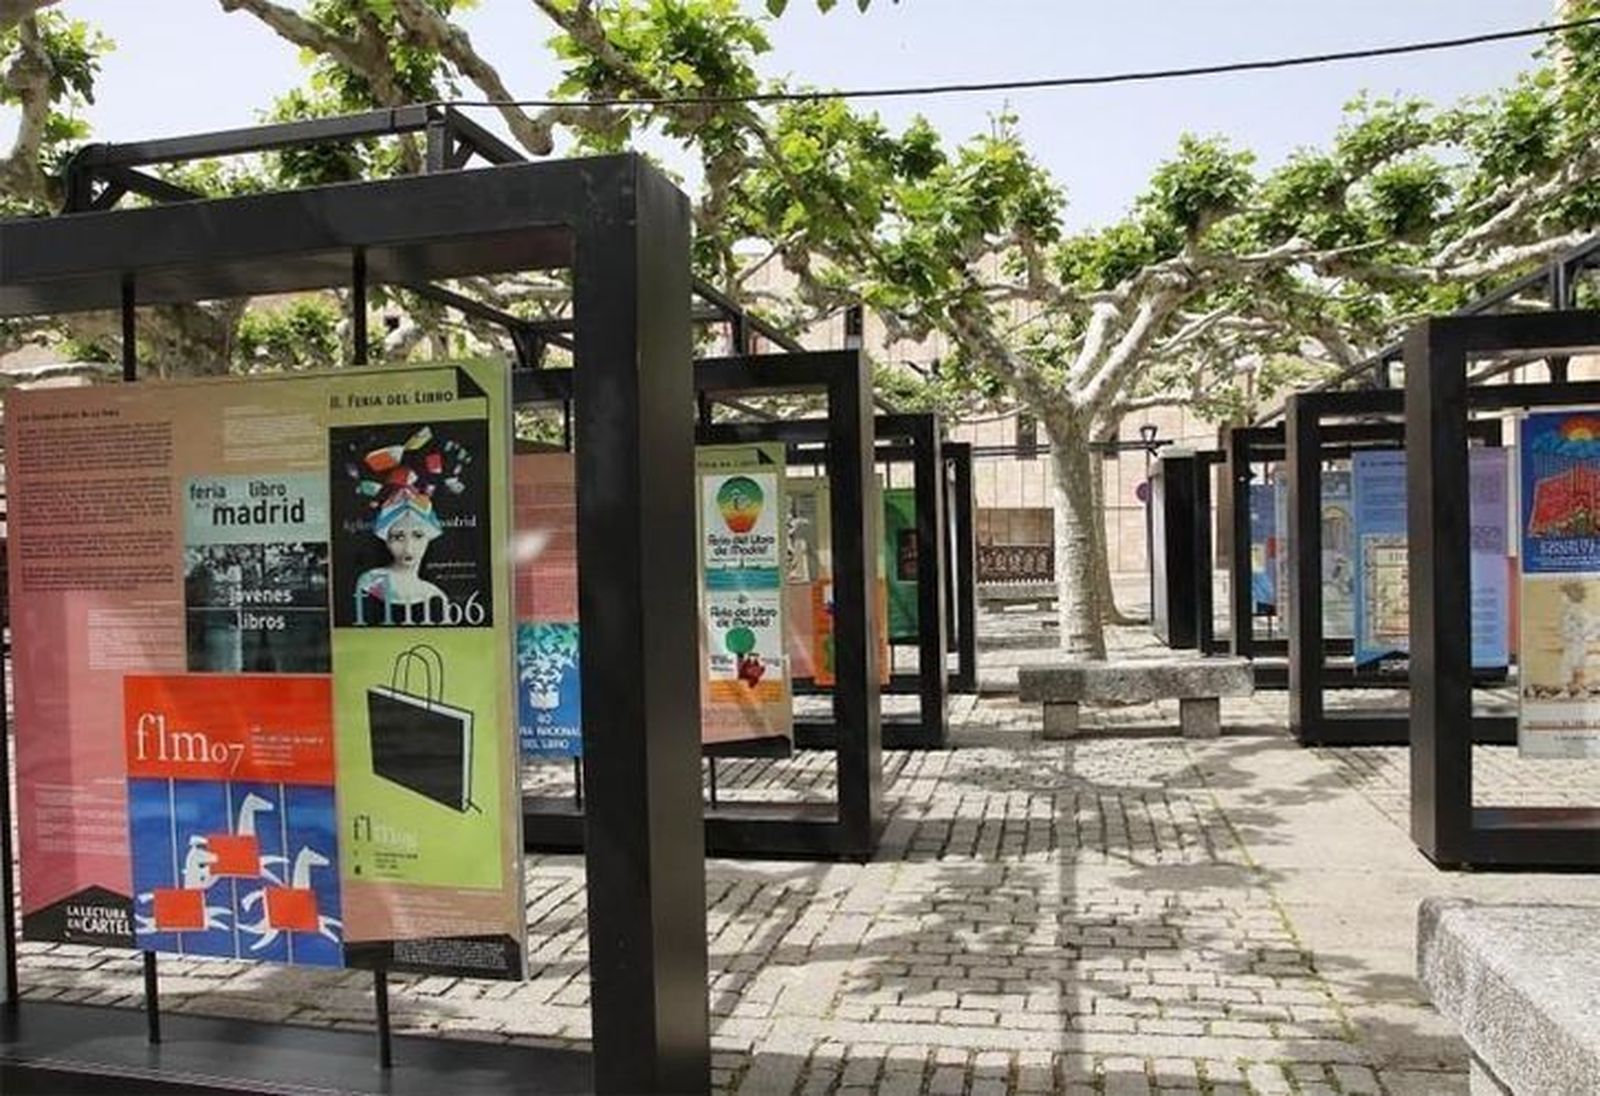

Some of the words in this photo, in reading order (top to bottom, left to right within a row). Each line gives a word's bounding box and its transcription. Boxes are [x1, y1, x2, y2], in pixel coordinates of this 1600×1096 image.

[348, 392, 382, 408] FERIA
[386, 392, 409, 406] DEL
[415, 389, 454, 404] LIBRO
[189, 483, 226, 501] feria
[248, 481, 287, 498] libro
[213, 497, 305, 526] madrid
[136, 712, 245, 777] flm07
[81, 906, 128, 920] LECTURA
[82, 916, 133, 937] CARTEL
